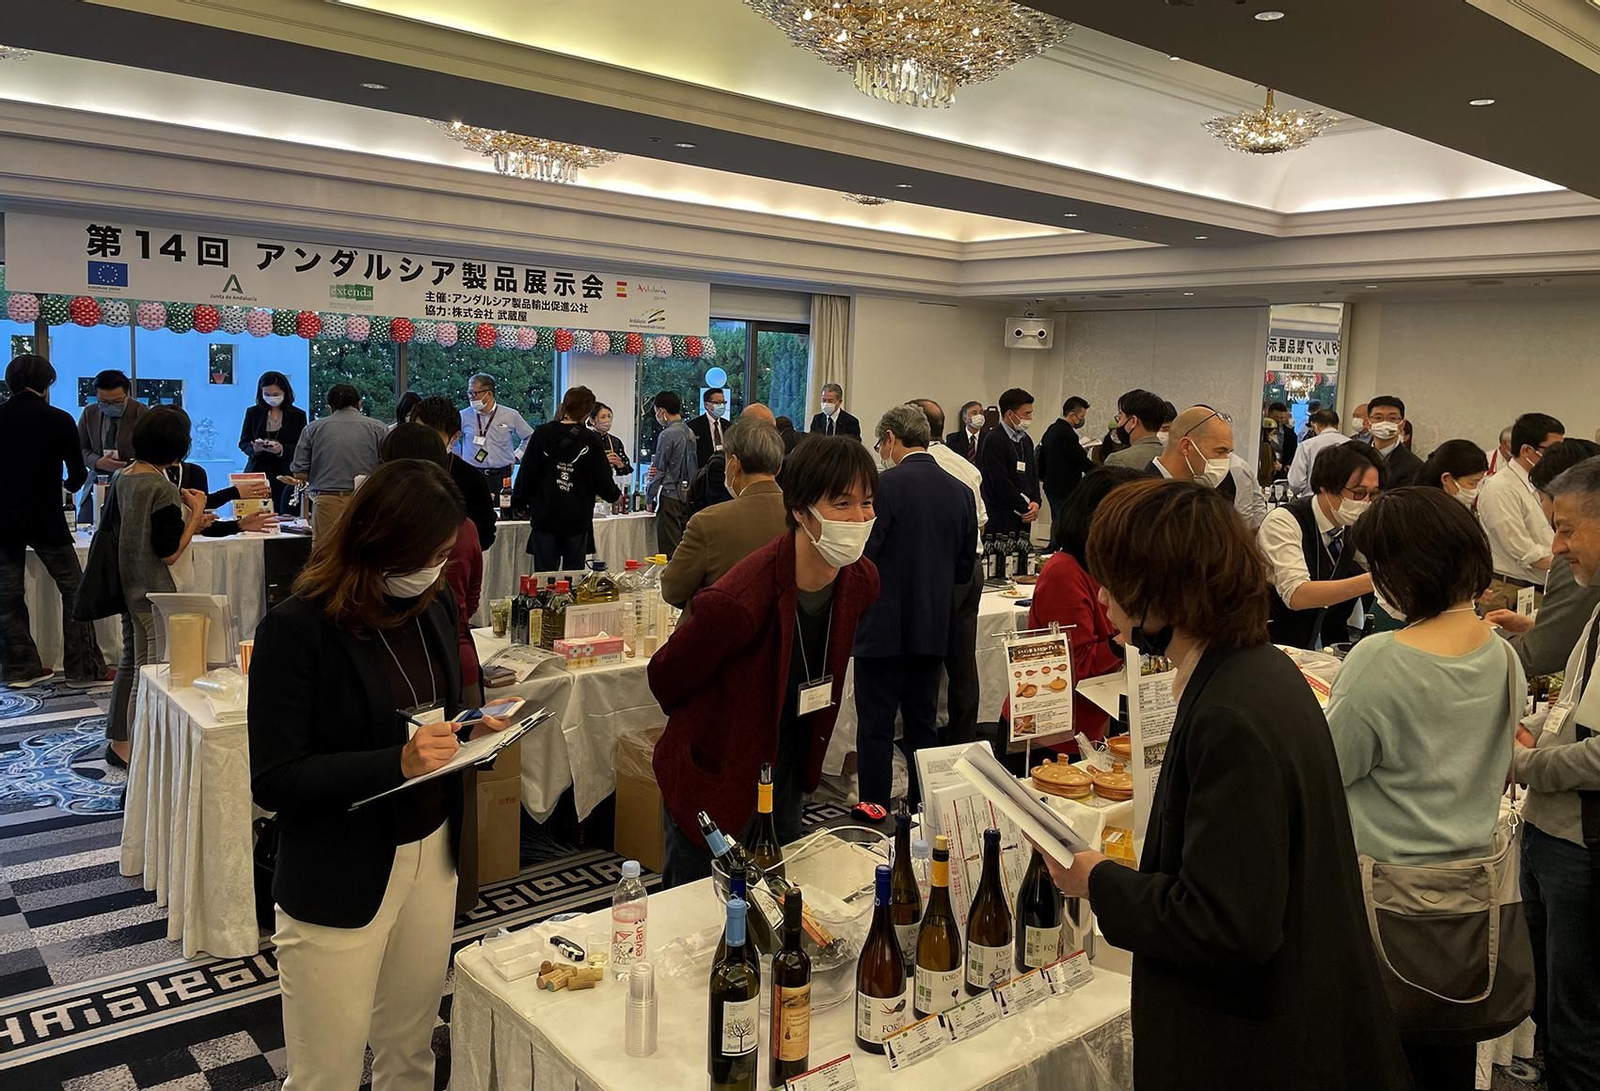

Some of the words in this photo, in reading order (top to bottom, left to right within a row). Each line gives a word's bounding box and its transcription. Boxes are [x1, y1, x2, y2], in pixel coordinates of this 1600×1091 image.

[85, 223, 230, 268] 第14回
[256, 242, 605, 300] アンダルシア製品展示会
[330, 287, 372, 298] extenda
[635, 925, 645, 957] evian
